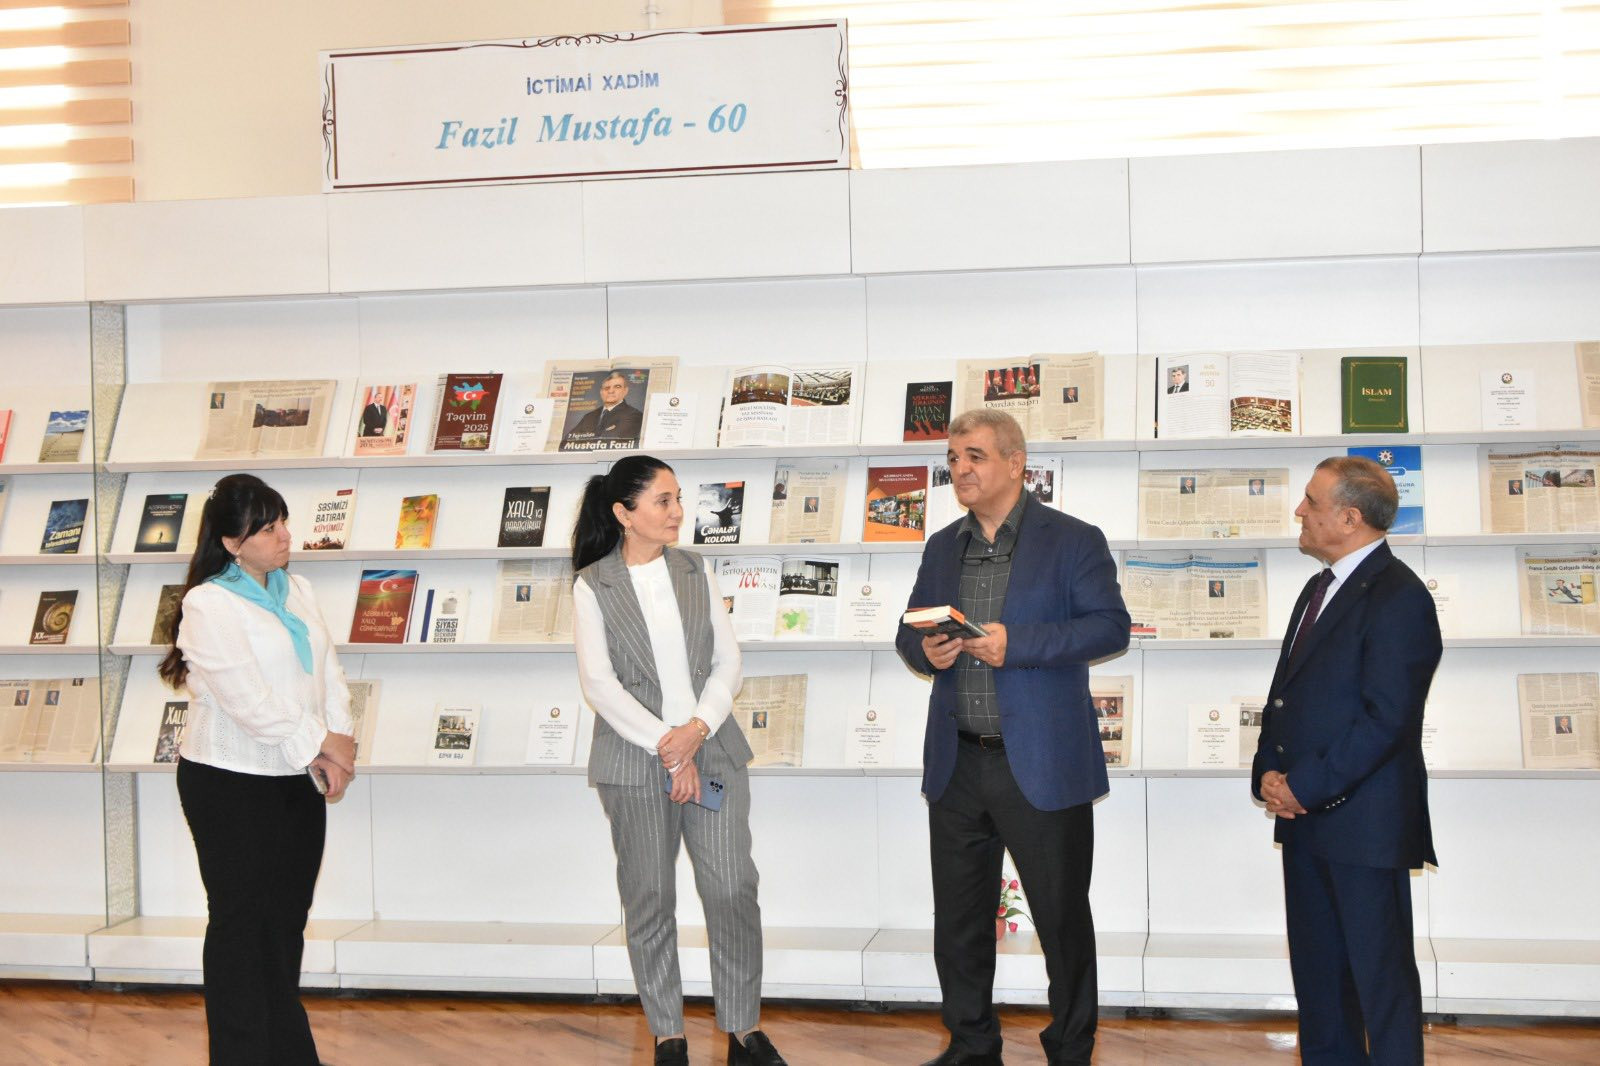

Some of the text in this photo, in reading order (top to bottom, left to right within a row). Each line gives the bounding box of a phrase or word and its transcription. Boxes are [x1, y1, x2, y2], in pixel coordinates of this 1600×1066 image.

[526, 70, 660, 95] İCTİMAİ XADİM
[435, 116, 519, 150] Fazil
[536, 106, 673, 146] Mustafa
[707, 102, 747, 134] 60
[1361, 386, 1392, 396] İSLAM
[446, 411, 487, 425] Təqvim
[463, 423, 489, 432] 2025
[564, 440, 635, 450] Mustafa Fazil
[505, 500, 535, 519] XALQ
[704, 534, 738, 544] KOLONU
[738, 570, 761, 589] 100
[360, 618, 377, 626] XALQ
